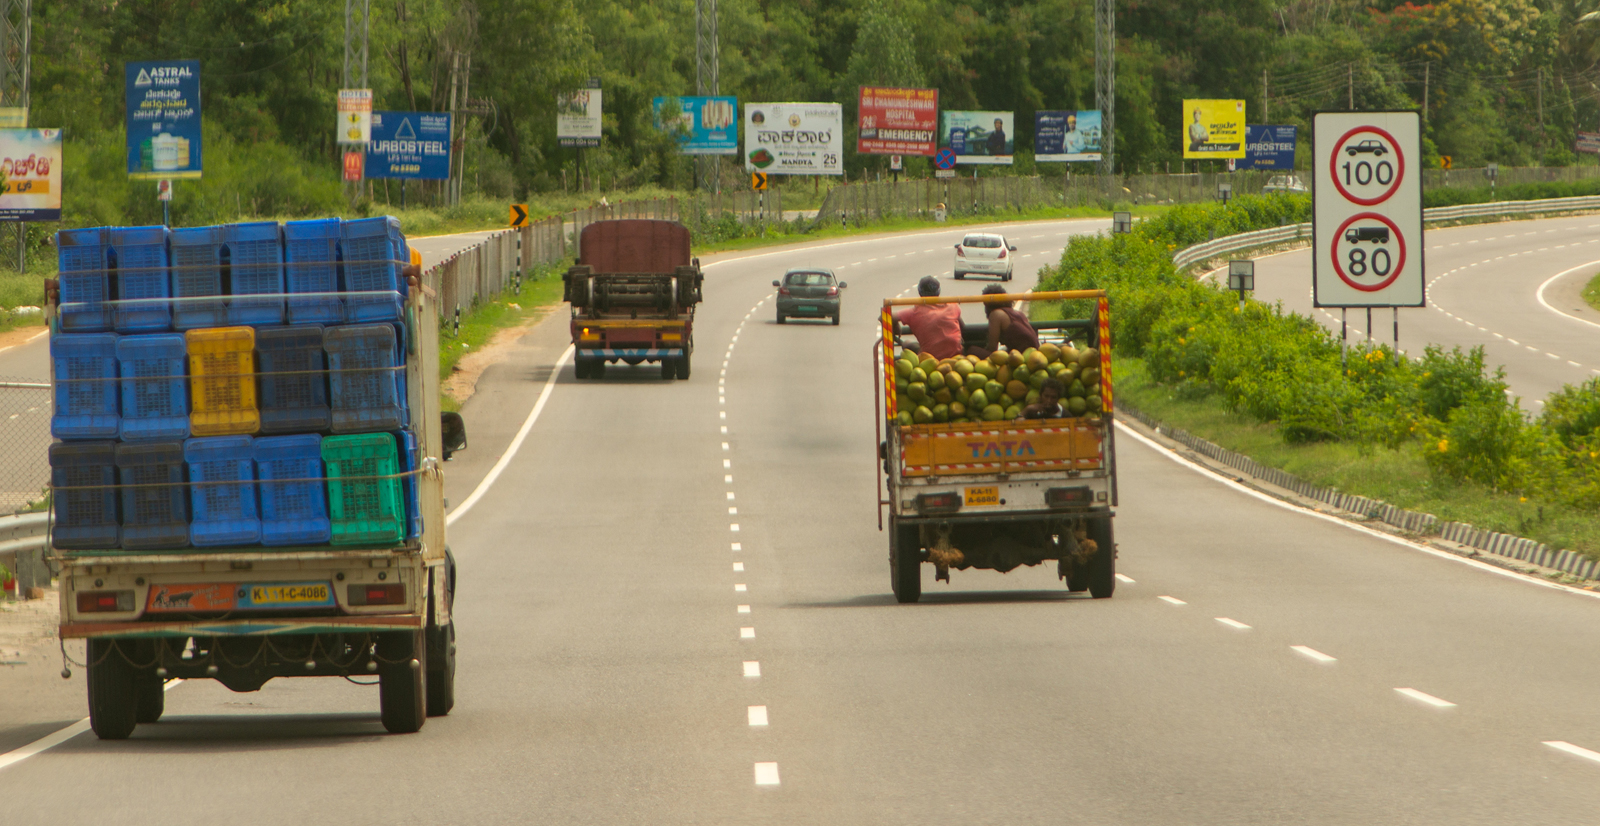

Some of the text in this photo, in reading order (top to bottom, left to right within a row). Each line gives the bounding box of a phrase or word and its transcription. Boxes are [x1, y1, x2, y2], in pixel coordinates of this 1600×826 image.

[150, 66, 192, 78] ASTRAL
[154, 77, 180, 86] TANKS
[341, 90, 369, 98] HOTEL
[862, 97, 935, 110] SRI CHAMUNDESHWARI
[885, 108, 916, 121] HOSPITAL
[878, 128, 934, 142] EMERGENCY
[1245, 142, 1295, 152] URBOSTEEL
[781, 158, 813, 166] MANDYA
[823, 153, 837, 166] 25
[1342, 160, 1394, 186] 100
[1348, 248, 1391, 276] 80
[967, 440, 1035, 458] TATA
